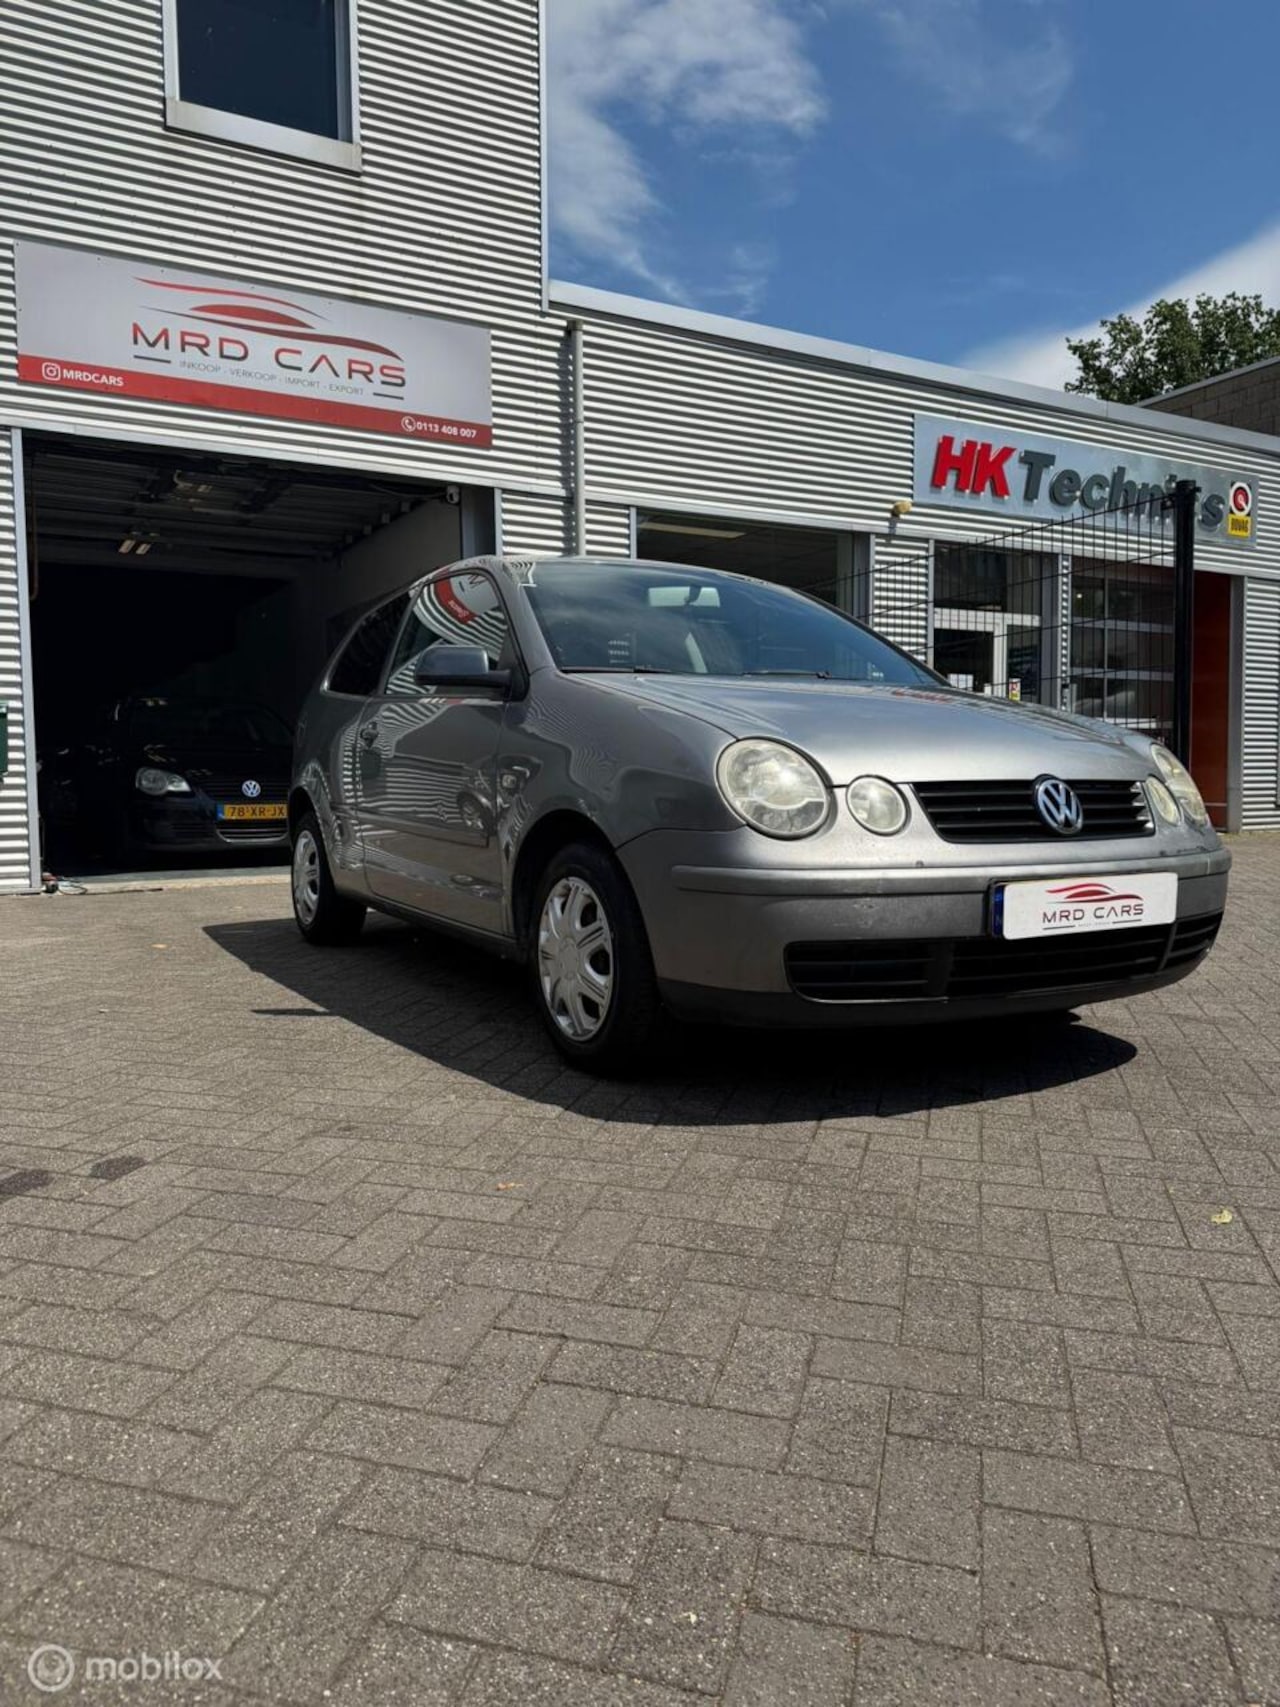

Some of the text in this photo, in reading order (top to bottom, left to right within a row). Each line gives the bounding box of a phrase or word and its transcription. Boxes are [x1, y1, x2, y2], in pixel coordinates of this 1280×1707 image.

[132, 321, 406, 388] MRD CARS
[63, 369, 124, 387] MRDCARS
[180, 360, 364, 396] INKOOP VERKOOP IMPORT EXPORT
[416, 421, 439, 433] 0113
[931, 435, 1225, 527] HK Technis
[1042, 903, 1144, 923] MRD CARS
